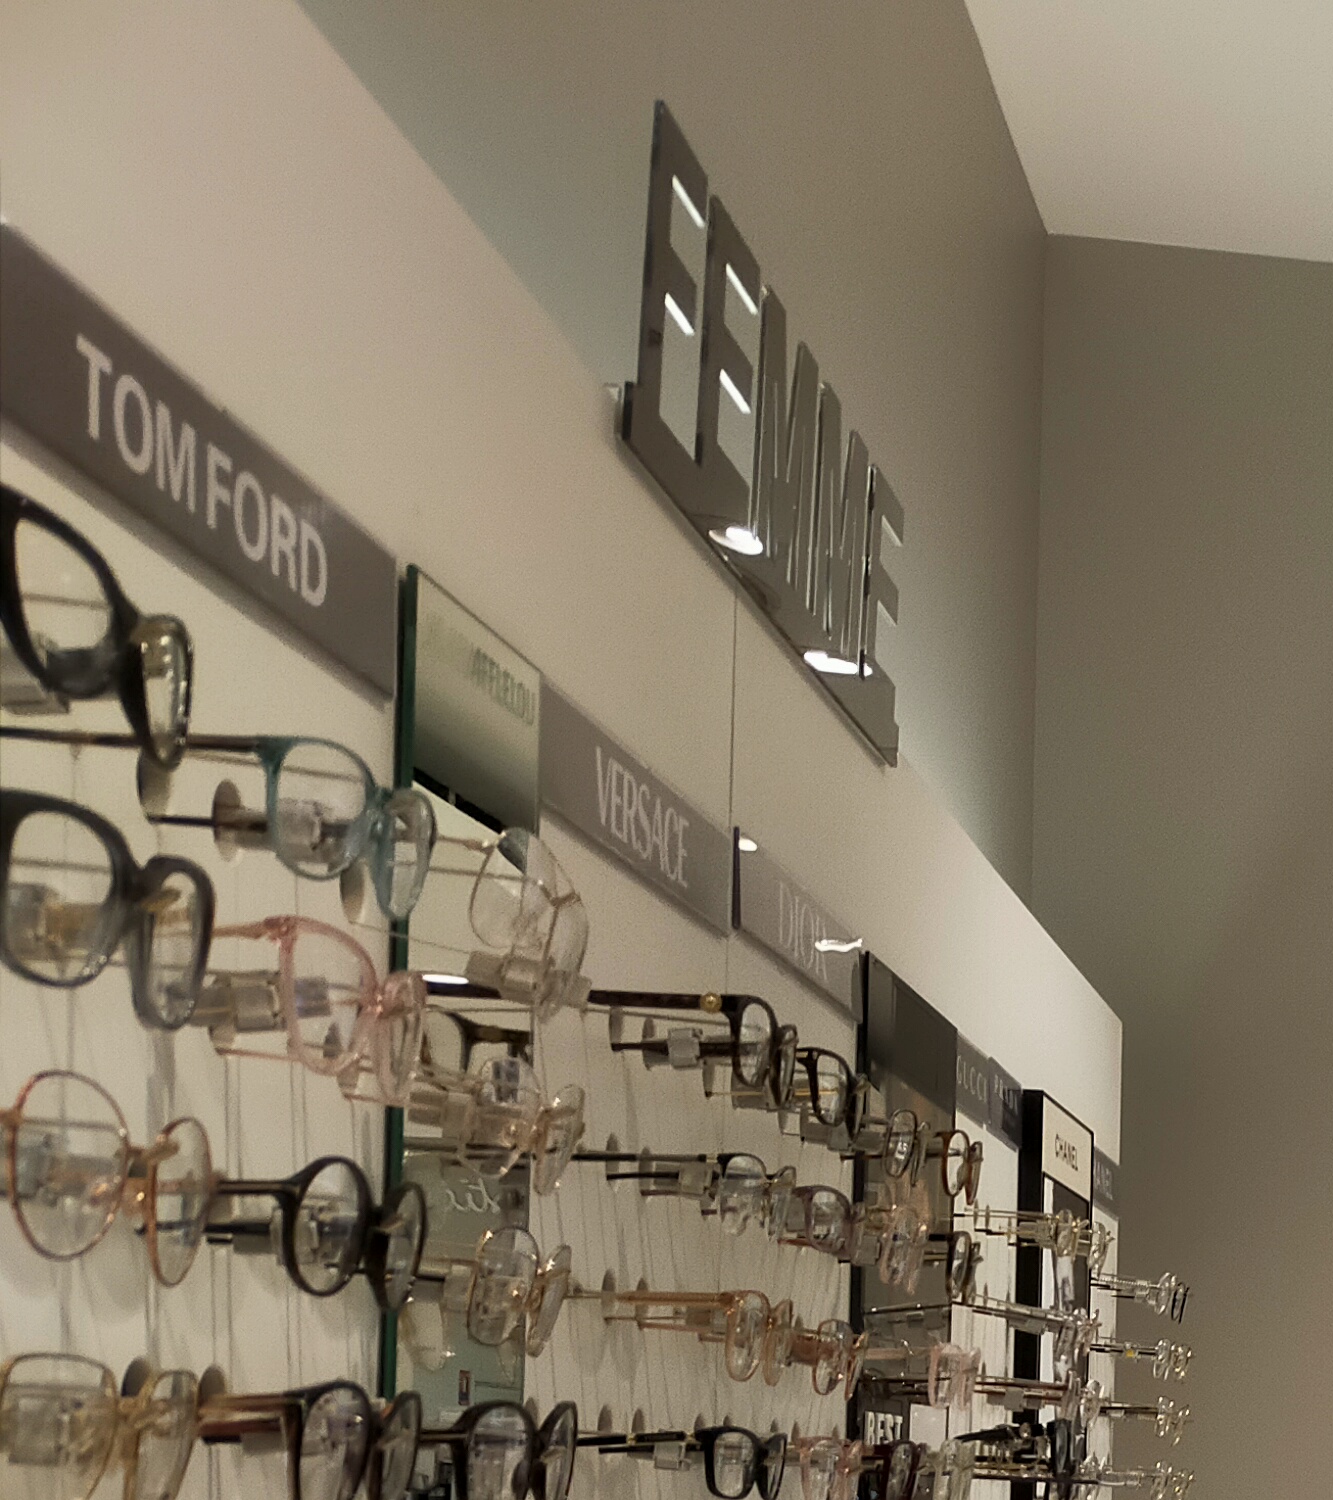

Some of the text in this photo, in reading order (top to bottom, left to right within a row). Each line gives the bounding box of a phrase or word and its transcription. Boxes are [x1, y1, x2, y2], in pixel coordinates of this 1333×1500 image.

[76, 333, 328, 607] TOM FORD
[596, 746, 690, 889] VERSACE
[1055, 1133, 1079, 1172] CHANEL
